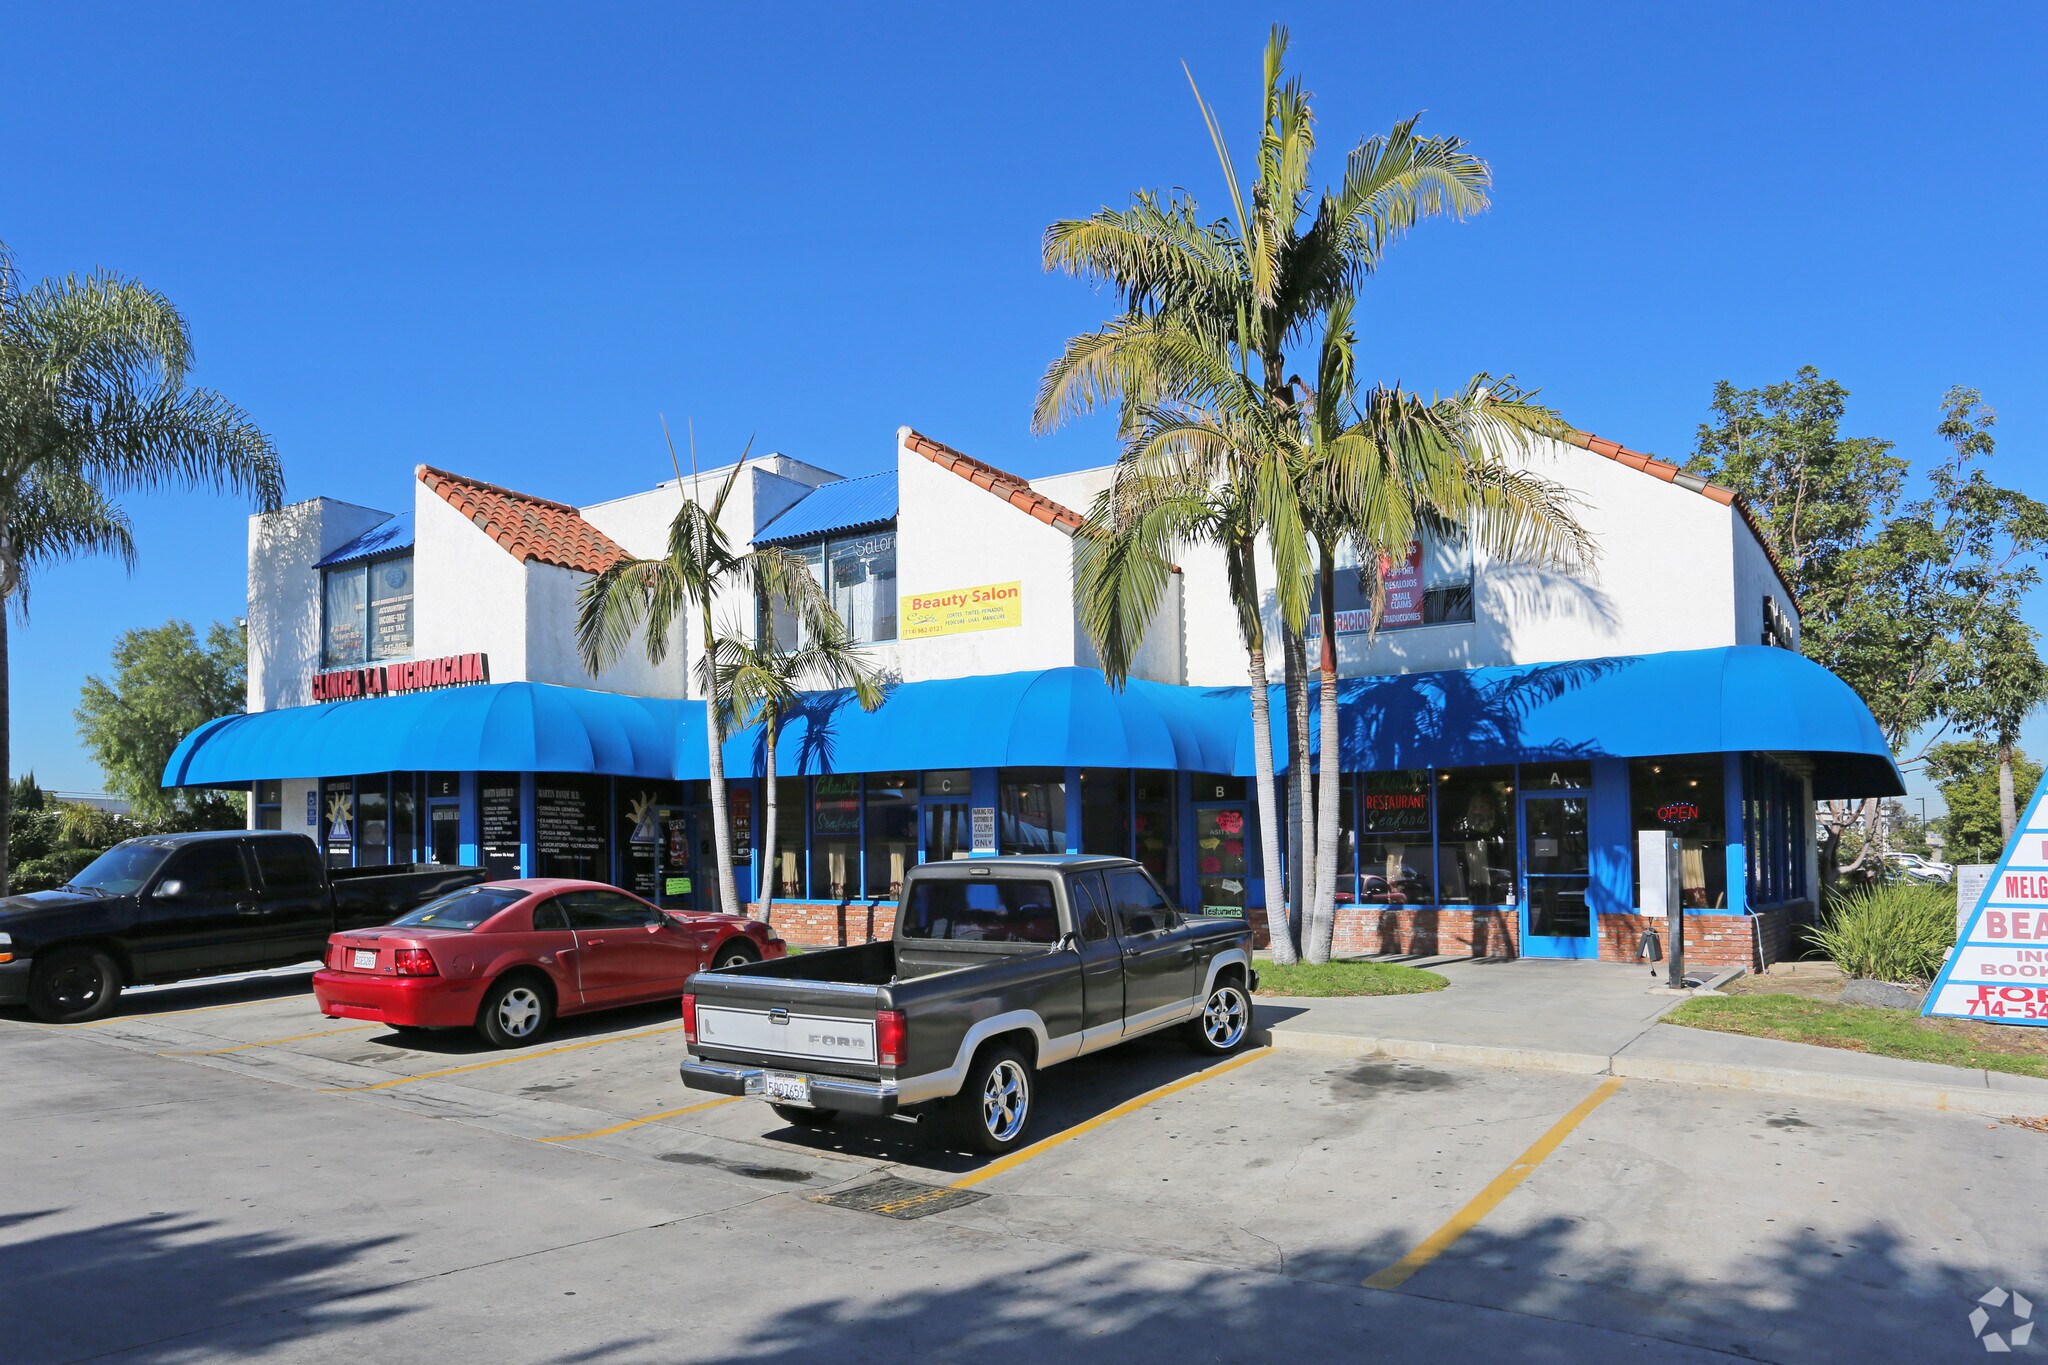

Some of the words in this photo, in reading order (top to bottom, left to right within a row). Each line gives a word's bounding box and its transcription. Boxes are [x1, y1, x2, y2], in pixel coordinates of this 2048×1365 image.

[856, 537, 896, 557] Salon
[1384, 579, 1417, 590] DESALOJOS
[912, 594, 968, 611] Beauty
[972, 587, 1018, 603] Salon
[1391, 592, 1411, 602] SMALL
[1391, 600, 1412, 610] CLAIMS
[946, 611, 963, 619] CORTES
[965, 609, 980, 617] TINTES
[981, 606, 1004, 615] PEINADOS
[1383, 612, 1421, 624] TRADUCCIONES
[380, 625, 395, 635] SALES
[395, 623, 405, 632] TAX
[1311, 611, 1371, 634] INRACION
[312, 669, 361, 700] CLINICA
[365, 666, 383, 694] LA
[388, 652, 484, 691] MICHOACANA
[1550, 772, 1561, 785] A
[443, 782, 449, 794] E
[942, 780, 951, 792] C
[1215, 786, 1225, 798] B
[1366, 794, 1426, 810] RESTAURANT
[1657, 805, 1699, 820] OPEN
[669, 820, 685, 830] OPEN
[1368, 810, 1427, 829] Seafood
[974, 824, 993, 832] COLIMA
[974, 839, 993, 847] ONLY
[2005, 875, 2048, 899] MELG
[2016, 950, 2048, 963] IN
[808, 1033, 866, 1049] FORD
